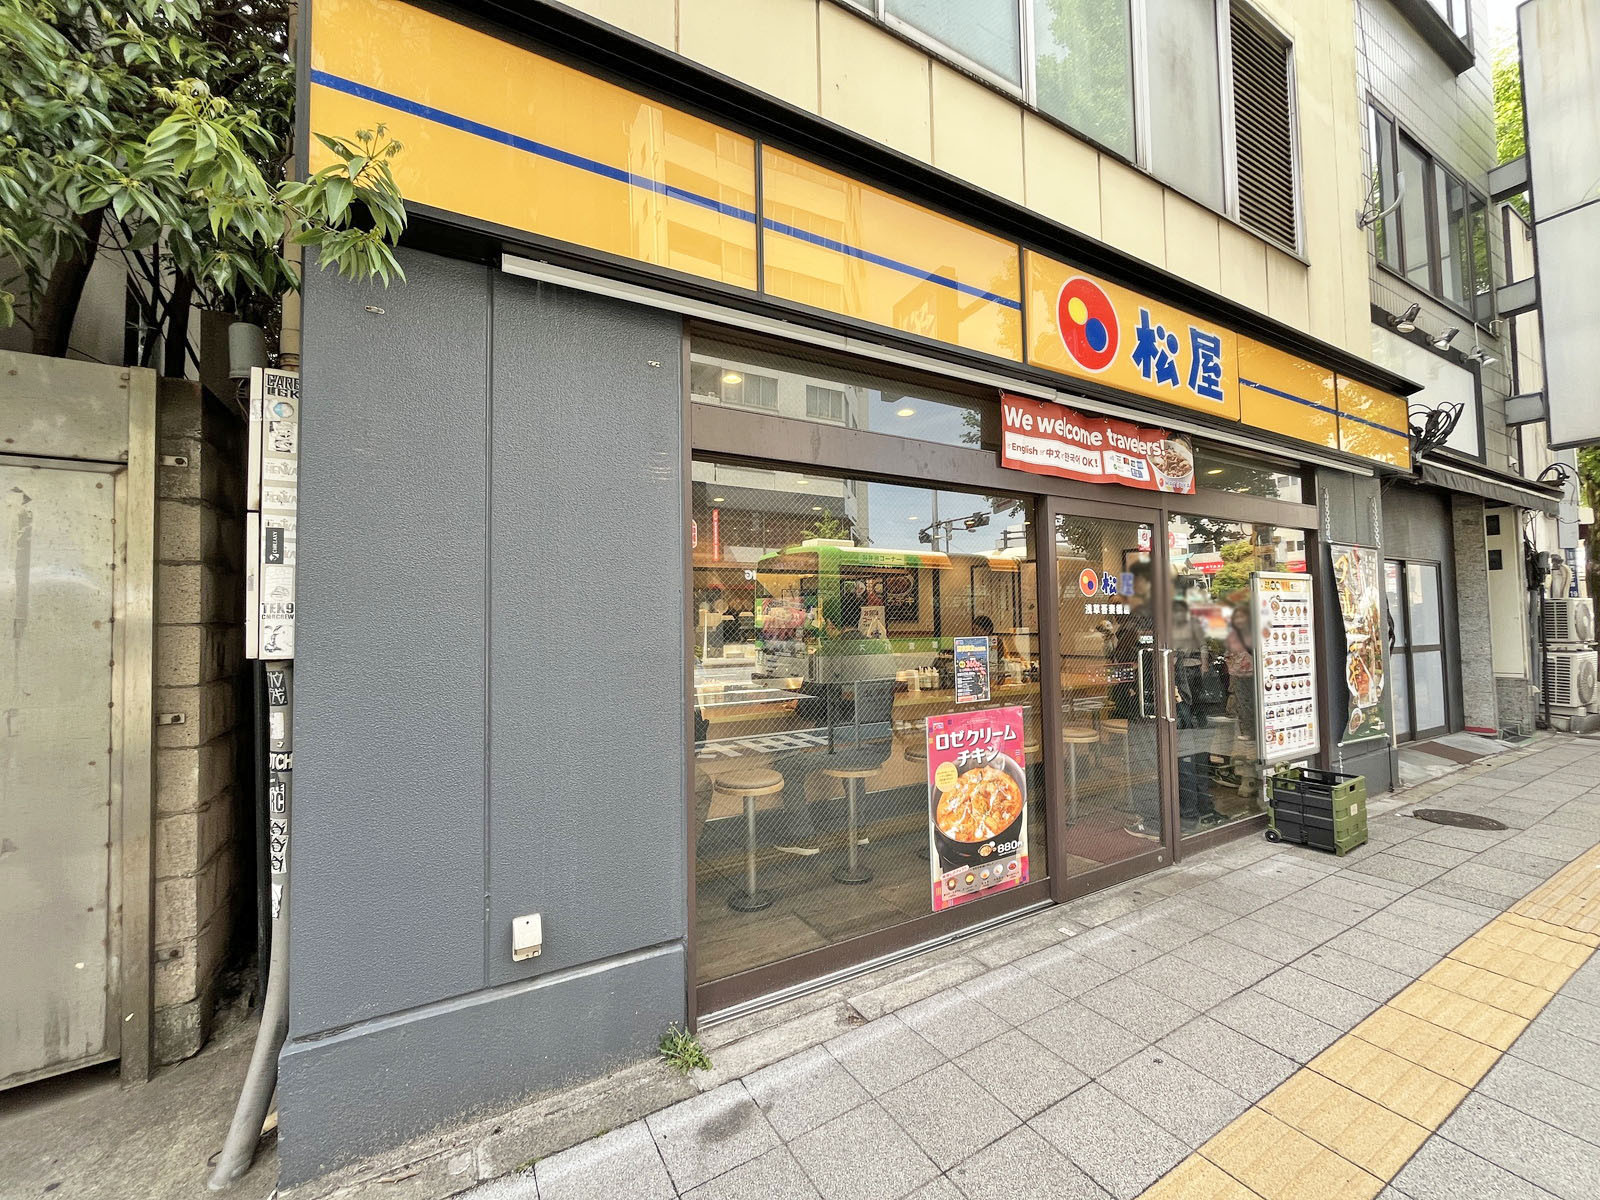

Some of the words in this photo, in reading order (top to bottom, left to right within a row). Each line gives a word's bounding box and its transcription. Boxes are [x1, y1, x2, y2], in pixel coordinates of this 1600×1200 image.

[1131, 307, 1223, 403] 松屋
[1004, 404, 1033, 431] We
[1036, 416, 1103, 446] welcome
[1106, 427, 1166, 456] travelers!
[1011, 442, 1038, 456] English
[1046, 447, 1060, 459] 中文
[1082, 456, 1098, 468] OK!
[261, 602, 295, 614] TEK9
[935, 724, 1017, 751] ロゼクリーム
[957, 746, 1000, 767] チキン
